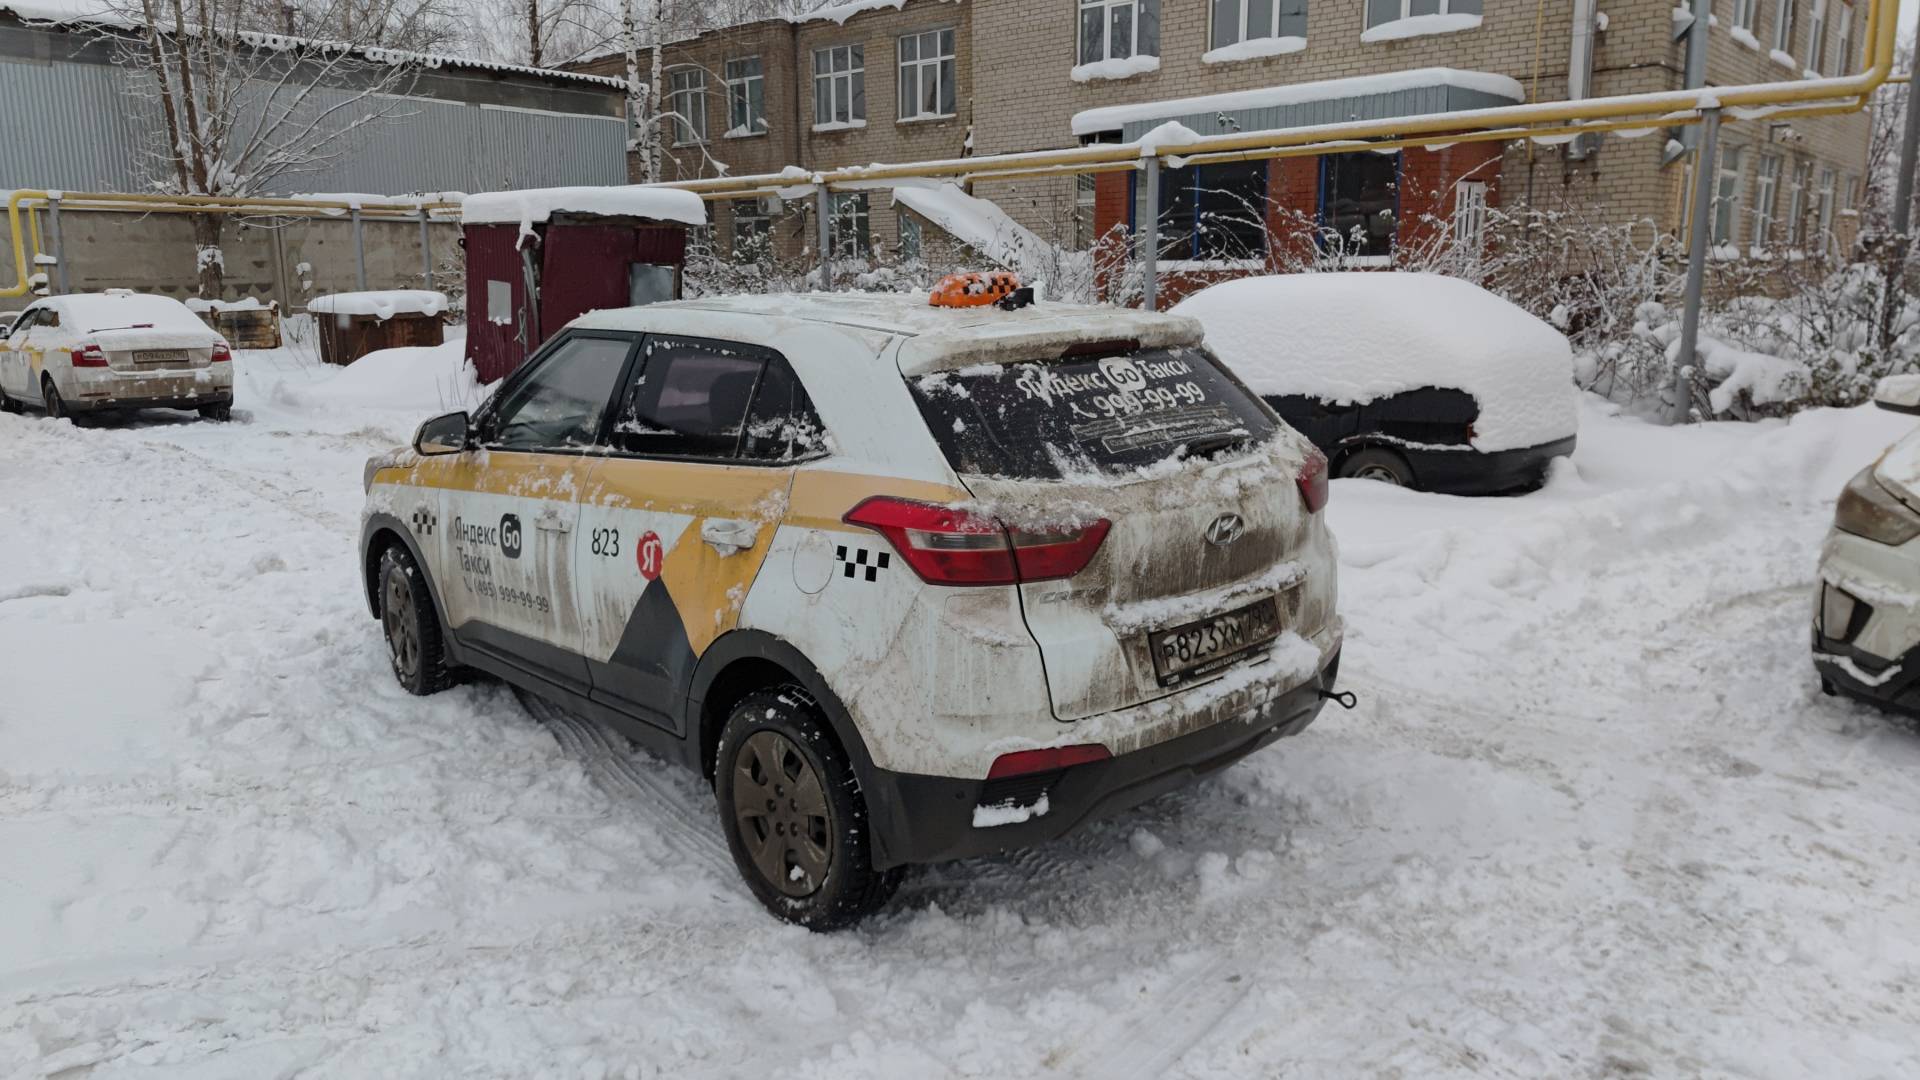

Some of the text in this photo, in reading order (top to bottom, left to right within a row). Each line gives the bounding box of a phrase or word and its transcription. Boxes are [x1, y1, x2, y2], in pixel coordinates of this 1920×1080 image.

[1016, 370, 1108, 400] Яндекс
[1136, 360, 1193, 379] Такси
[1093, 381, 1206, 417] 999-99-99
[454, 516, 521, 550] Яндекс Go
[591, 528, 620, 557] 823
[456, 547, 492, 576] Такси
[641, 539, 661, 573] Я
[473, 577, 550, 613] (495) 999-99-99
